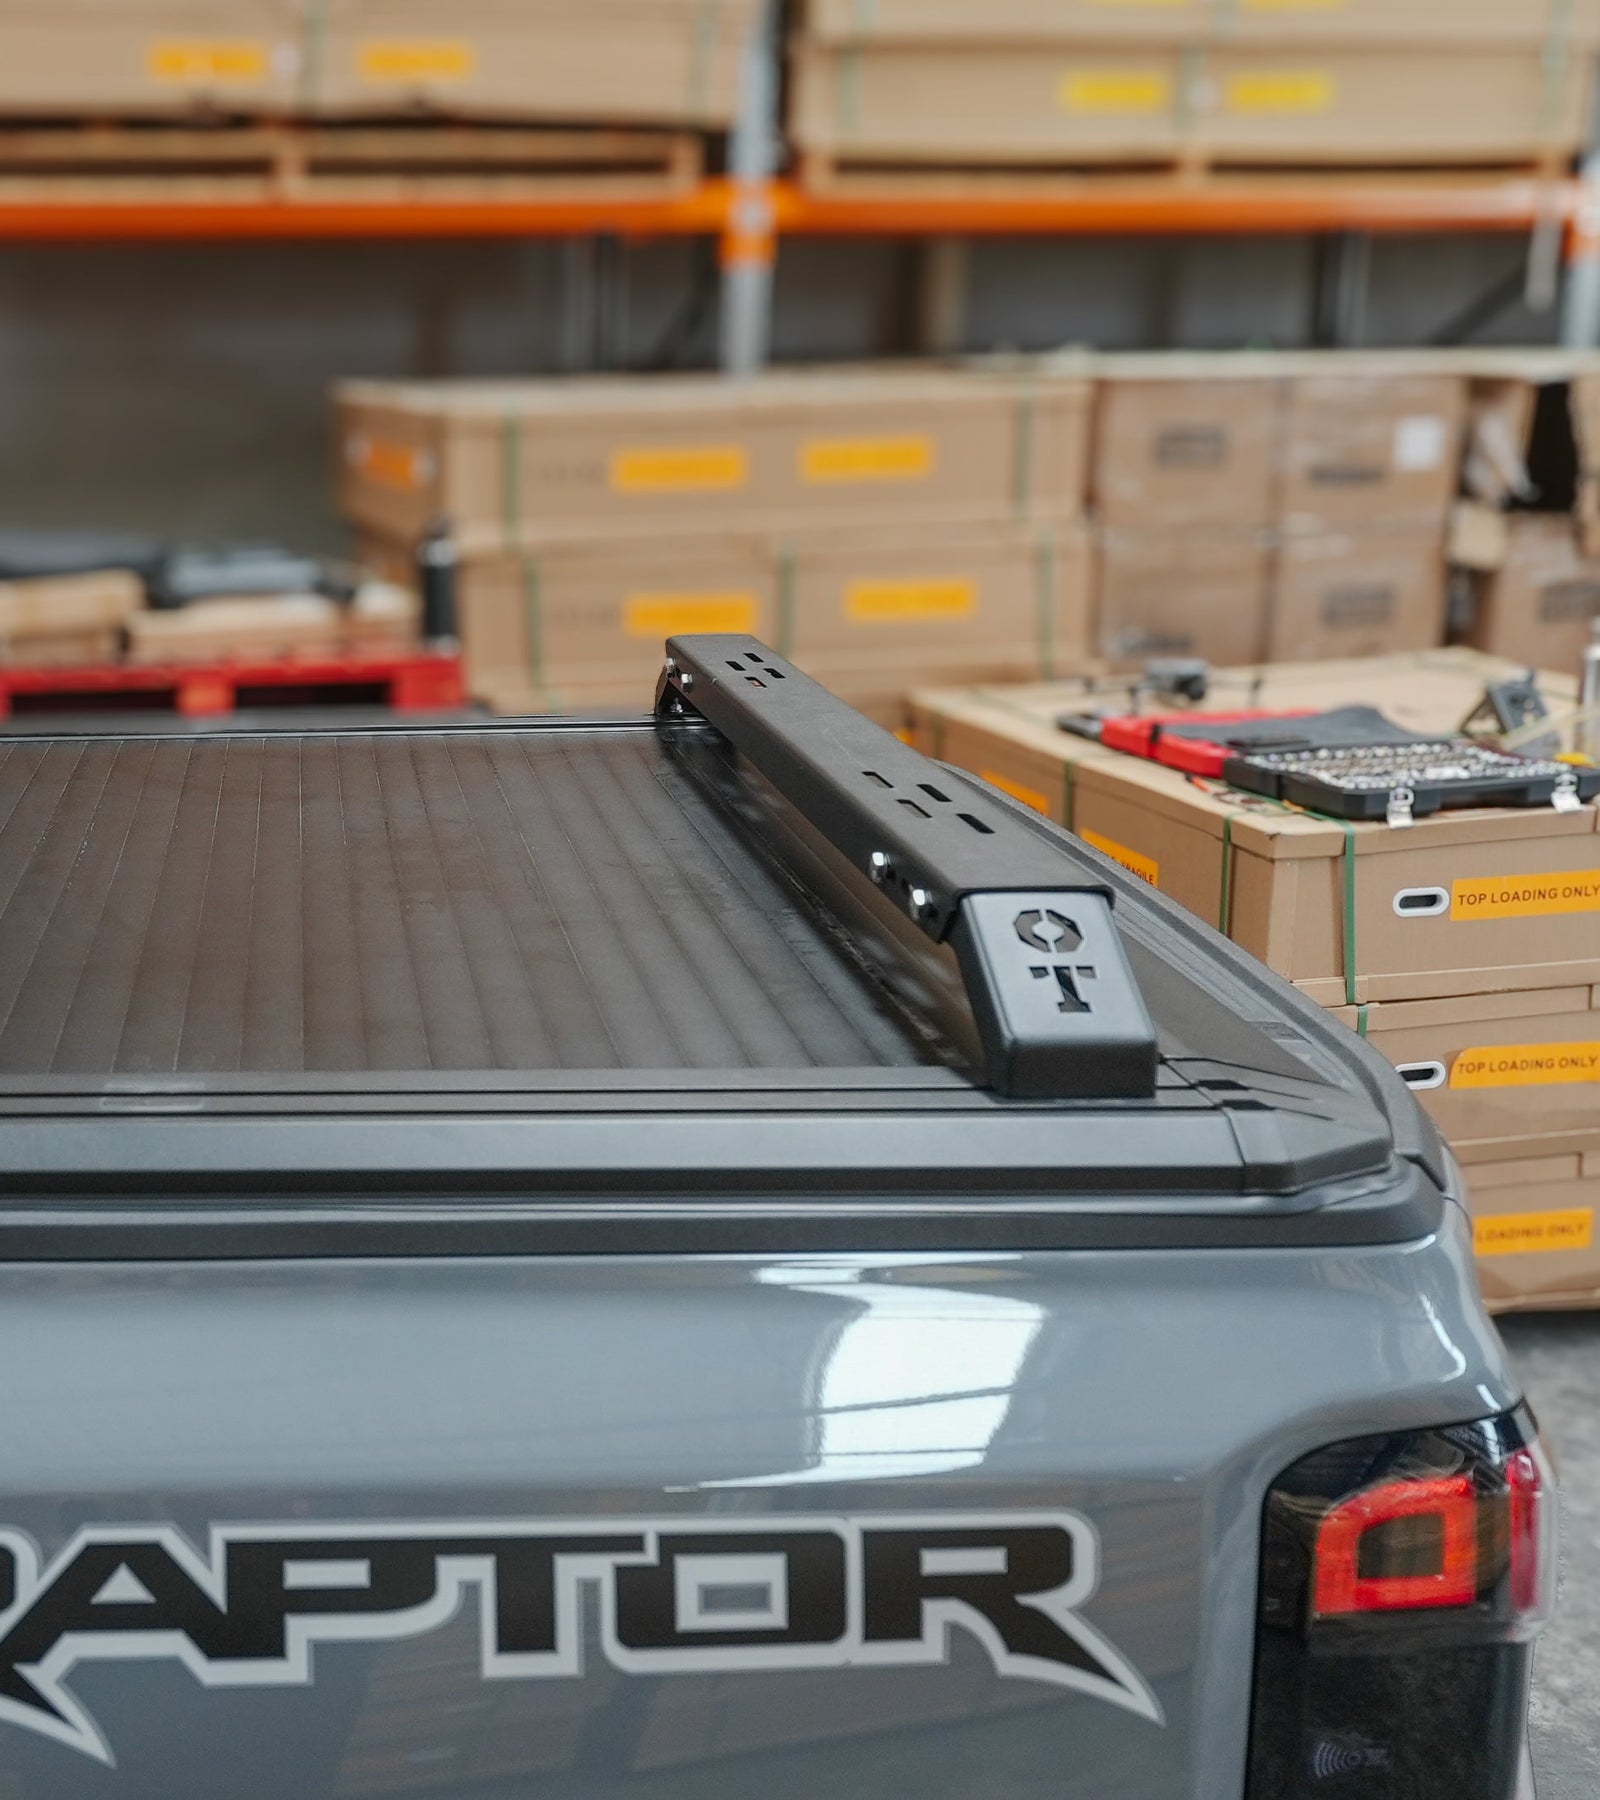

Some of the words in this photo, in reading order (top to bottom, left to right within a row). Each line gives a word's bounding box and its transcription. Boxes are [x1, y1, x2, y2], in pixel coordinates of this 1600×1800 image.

[1458, 893, 1487, 905] TOP
[1491, 888, 1558, 904] LOADING
[1562, 884, 1600, 899] ONLY
[1458, 1061, 1486, 1074] TOP
[1489, 1058, 1555, 1072] LOADING
[1559, 1055, 1598, 1069] ONLY
